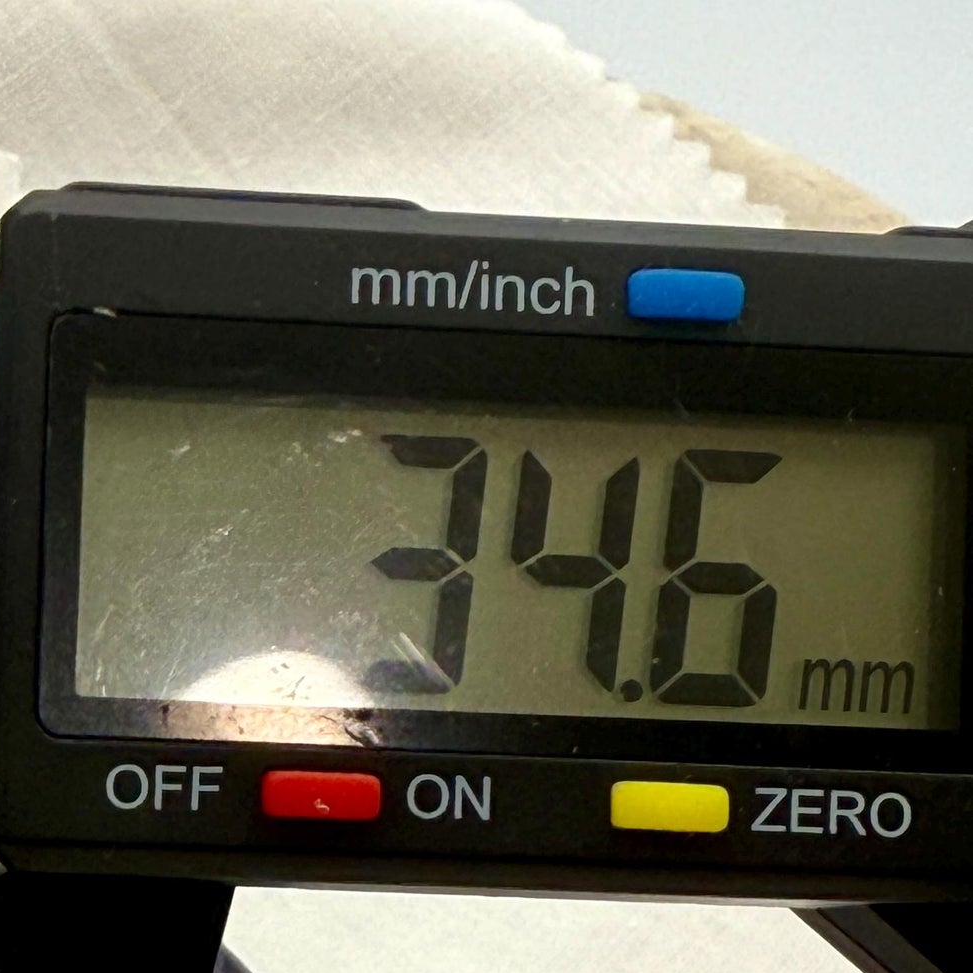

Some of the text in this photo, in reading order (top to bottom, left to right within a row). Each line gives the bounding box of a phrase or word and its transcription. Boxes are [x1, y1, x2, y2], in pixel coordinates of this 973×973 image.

[350, 260, 595, 317] mm/inch
[362, 434, 915, 715] 34.6 mm
[105, 764, 224, 813] OFF
[407, 774, 492, 822] ON
[751, 787, 913, 839] ZERO
